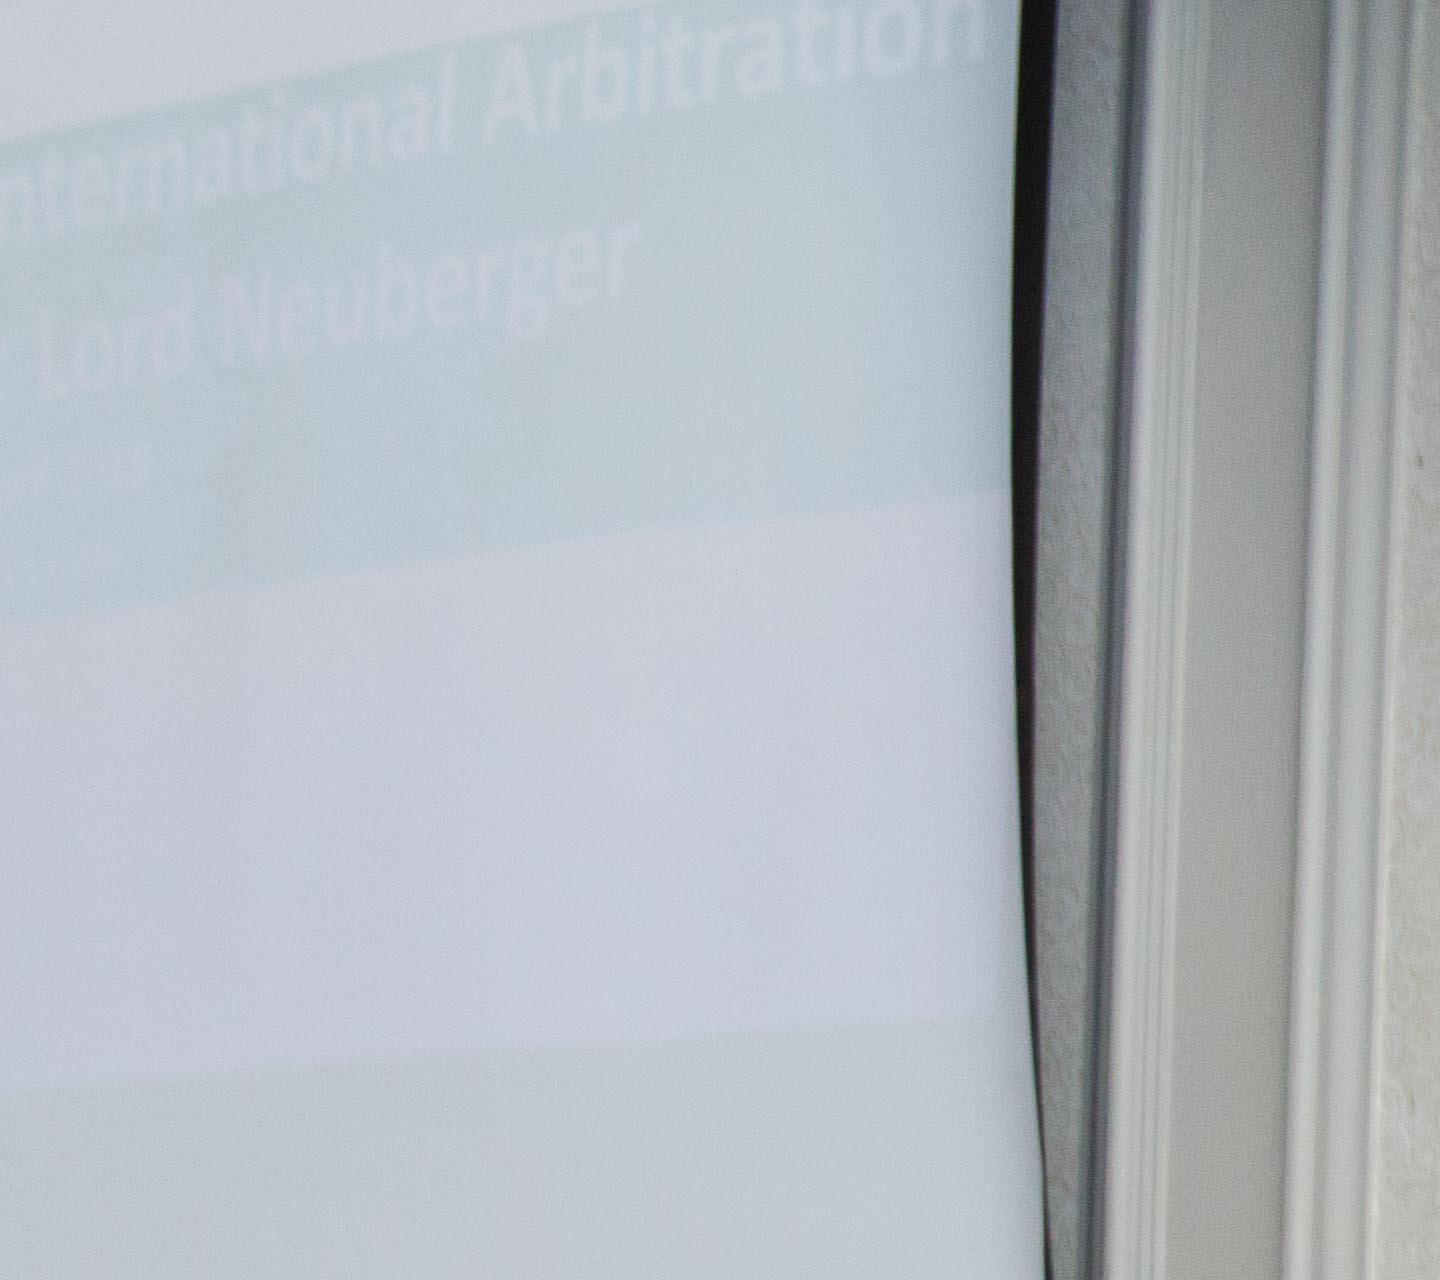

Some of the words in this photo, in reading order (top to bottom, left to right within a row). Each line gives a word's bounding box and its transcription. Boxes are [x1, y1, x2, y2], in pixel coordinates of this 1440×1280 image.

[480, 0, 986, 145] Arbitration
[32, 270, 190, 400] Lord
[215, 216, 642, 366] Neuberger
